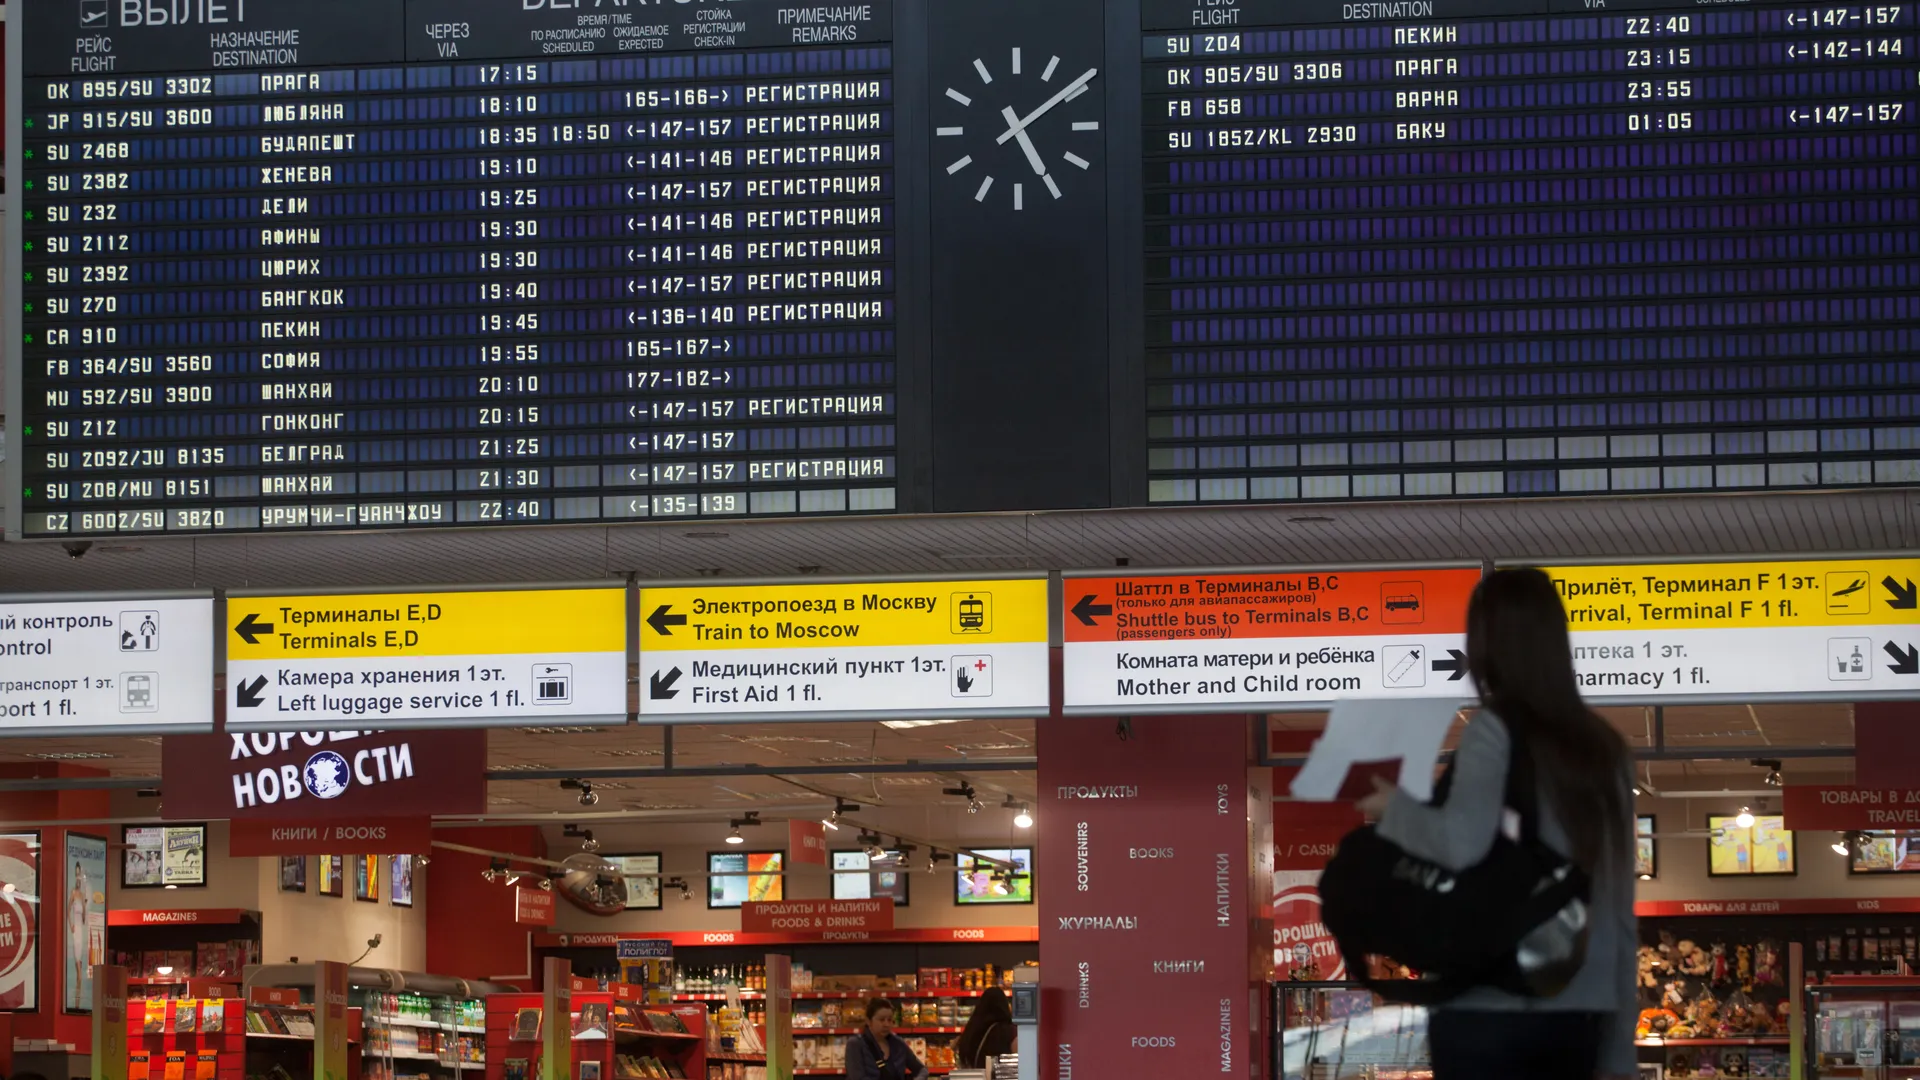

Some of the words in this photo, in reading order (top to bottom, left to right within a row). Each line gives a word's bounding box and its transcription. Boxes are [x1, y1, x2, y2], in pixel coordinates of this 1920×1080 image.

[697, 8, 732, 20] СТОЙКА
[778, 6, 870, 24] ПРИМЕЧАНИЕ
[1193, 9, 1240, 25] FLIGHT
[1344, 1, 1432, 19] DESTINATION
[578, 14, 632, 26] ВРЕМЯ/TIME
[684, 22, 745, 35] РЕГИСТРАЦИИ
[210, 30, 300, 48] НАЗНАЧЕНИЕ
[426, 23, 469, 38] ЧЕРЕЗ
[531, 30, 543, 40] ПО
[546, 28, 605, 39] РАСПИСАНИЮ
[614, 25, 668, 38] ОЖИДАЕМОЕ
[793, 25, 856, 42] REMARKS
[77, 35, 111, 52] РЕЙС
[438, 42, 458, 57] VIA
[543, 41, 594, 53] SCHEDULED
[619, 39, 663, 50] EXPECTED
[695, 36, 734, 47] CHECK-IN
[72, 56, 116, 71] FLIGHT
[214, 49, 296, 66] DESTINATION
[1168, 69, 1190, 84] OK
[1206, 66, 1278, 83] 905/SU
[1294, 63, 1341, 79] 3306
[1396, 59, 1456, 76] ПРАГА
[1628, 49, 1689, 66] 23:15
[48, 84, 68, 99] OK
[84, 80, 152, 97] 895/SU
[167, 78, 211, 94] 3302
[262, 74, 319, 91] ПРАГА
[481, 65, 536, 82] 17:15
[48, 145, 68, 160] SU
[83, 143, 128, 159] 2468
[262, 134, 354, 152] БУДАПЕШТ
[481, 127, 536, 144] 18:35
[553, 125, 609, 141] 18:50
[747, 114, 879, 133] РЕГИСТРАЦИЯ
[1169, 132, 1190, 147] SU
[1209, 129, 1291, 146] 1852/KL
[1308, 126, 1355, 142] 2930
[1397, 123, 1444, 139] БАКУ
[1629, 113, 1691, 130] 01:05
[48, 299, 68, 313] SU
[83, 297, 116, 312] 270
[262, 290, 343, 306] БАНГКОК
[481, 283, 536, 299] 19:40
[748, 271, 880, 290] РЕГИСТРАЦИЯ
[47, 515, 68, 530] CZ
[83, 512, 163, 529] 6002/SU
[179, 511, 223, 526] 3820
[263, 504, 440, 524] УРУМЧИ-ГУАНЧЖОУ
[481, 502, 538, 518] 22:40
[1116, 582, 1172, 596] Шаттл
[1180, 584, 1189, 594] в
[1195, 578, 1301, 595] Терминалы
[1643, 577, 1750, 597] Терминал
[1758, 574, 1769, 590] F
[693, 599, 836, 616] Электропоезд
[844, 599, 854, 610] в
[863, 595, 936, 613] Москву
[1117, 598, 1165, 609] (только
[1170, 598, 1194, 608] для
[1200, 591, 1316, 606] авиапассажиров)
[280, 608, 399, 627] Терминалы
[408, 604, 441, 623] E,D
[1116, 611, 1178, 628] Shuttle
[1185, 610, 1217, 626] bus
[1223, 612, 1239, 624] to
[1245, 608, 1331, 623] Terminals
[1339, 607, 1368, 621] B,C
[1566, 603, 1631, 625] rrival,
[1639, 602, 1732, 620] Terminal
[1741, 601, 1752, 617] F
[1762, 601, 1769, 617] 1
[1779, 600, 1797, 616] fl.
[24, 616, 112, 631] контроль
[693, 624, 742, 640] Train
[750, 624, 768, 639] to
[777, 622, 859, 638] Moscow
[280, 632, 376, 649] Terminals
[385, 631, 418, 649] E,D
[1117, 628, 1195, 640] (passengers
[1200, 625, 1231, 638] only)
[1118, 653, 1198, 669] Комната
[1204, 654, 1272, 669] матери
[1280, 653, 1290, 664] и
[1297, 647, 1374, 668] ребёнка
[1570, 645, 1634, 660] птека
[1643, 641, 1650, 657] 1
[1662, 645, 1687, 657] эт.
[693, 658, 837, 679] Медицинский
[846, 661, 904, 678] пункт
[279, 670, 353, 688] Камера
[361, 670, 459, 687] хранения
[1118, 679, 1190, 695] Mother
[1198, 677, 1235, 693] and
[1244, 675, 1297, 692] Child
[1307, 677, 1360, 690] room
[1573, 669, 1664, 689] harmacy
[1673, 668, 1680, 684] 1
[1691, 667, 1709, 683] fl.
[279, 695, 315, 711] Left
[324, 695, 402, 714] luggage
[411, 692, 482, 708] service
[491, 691, 497, 706] 1
[506, 690, 524, 706] fl.
[693, 687, 738, 703] First
[745, 685, 777, 702] Aid
[787, 685, 794, 701] 1
[803, 685, 821, 700] fl.
[1057, 786, 1138, 799] ПРОДУКТЫ
[1218, 784, 1228, 815] TOYS
[1820, 790, 1882, 804] ТОВАРЫ
[1889, 791, 1898, 803] В
[272, 828, 316, 840] КНИГИ
[336, 827, 386, 839] BOOKS
[1078, 822, 1088, 891] SOUVENIRS
[1130, 847, 1174, 859] BOOKS
[1217, 854, 1230, 927] НАПИТКИ
[755, 903, 814, 915] ПРОДУКТЫ
[818, 903, 826, 912] И
[830, 902, 880, 912] НАПИТКИ
[1684, 903, 1722, 913] ТОВАРЫ
[1726, 903, 1746, 912] ДЛЯ
[1750, 901, 1779, 911] ДЕТЕЙ
[1857, 901, 1879, 910] KIDS
[143, 912, 197, 922] MAGAZINES
[772, 918, 810, 928] FOODS
[815, 918, 823, 928] &
[827, 917, 865, 926] DRINKS
[1058, 916, 1138, 930] ЖУРНАЛЫ
[573, 935, 618, 944] ПРОДУКТЫ
[704, 934, 734, 942] FOODS
[822, 931, 869, 940] ПРОДУКТЫ
[953, 930, 984, 939] FOODS
[1274, 921, 1333, 944] ОРОШИ
[624, 948, 668, 956] ПОЛИГЛОТ
[1154, 960, 1204, 973] КНИГИ
[1079, 962, 1089, 1008] DRINKS
[1132, 1036, 1176, 1047] FOODS
[1220, 998, 1231, 1072] MAGAZINES
